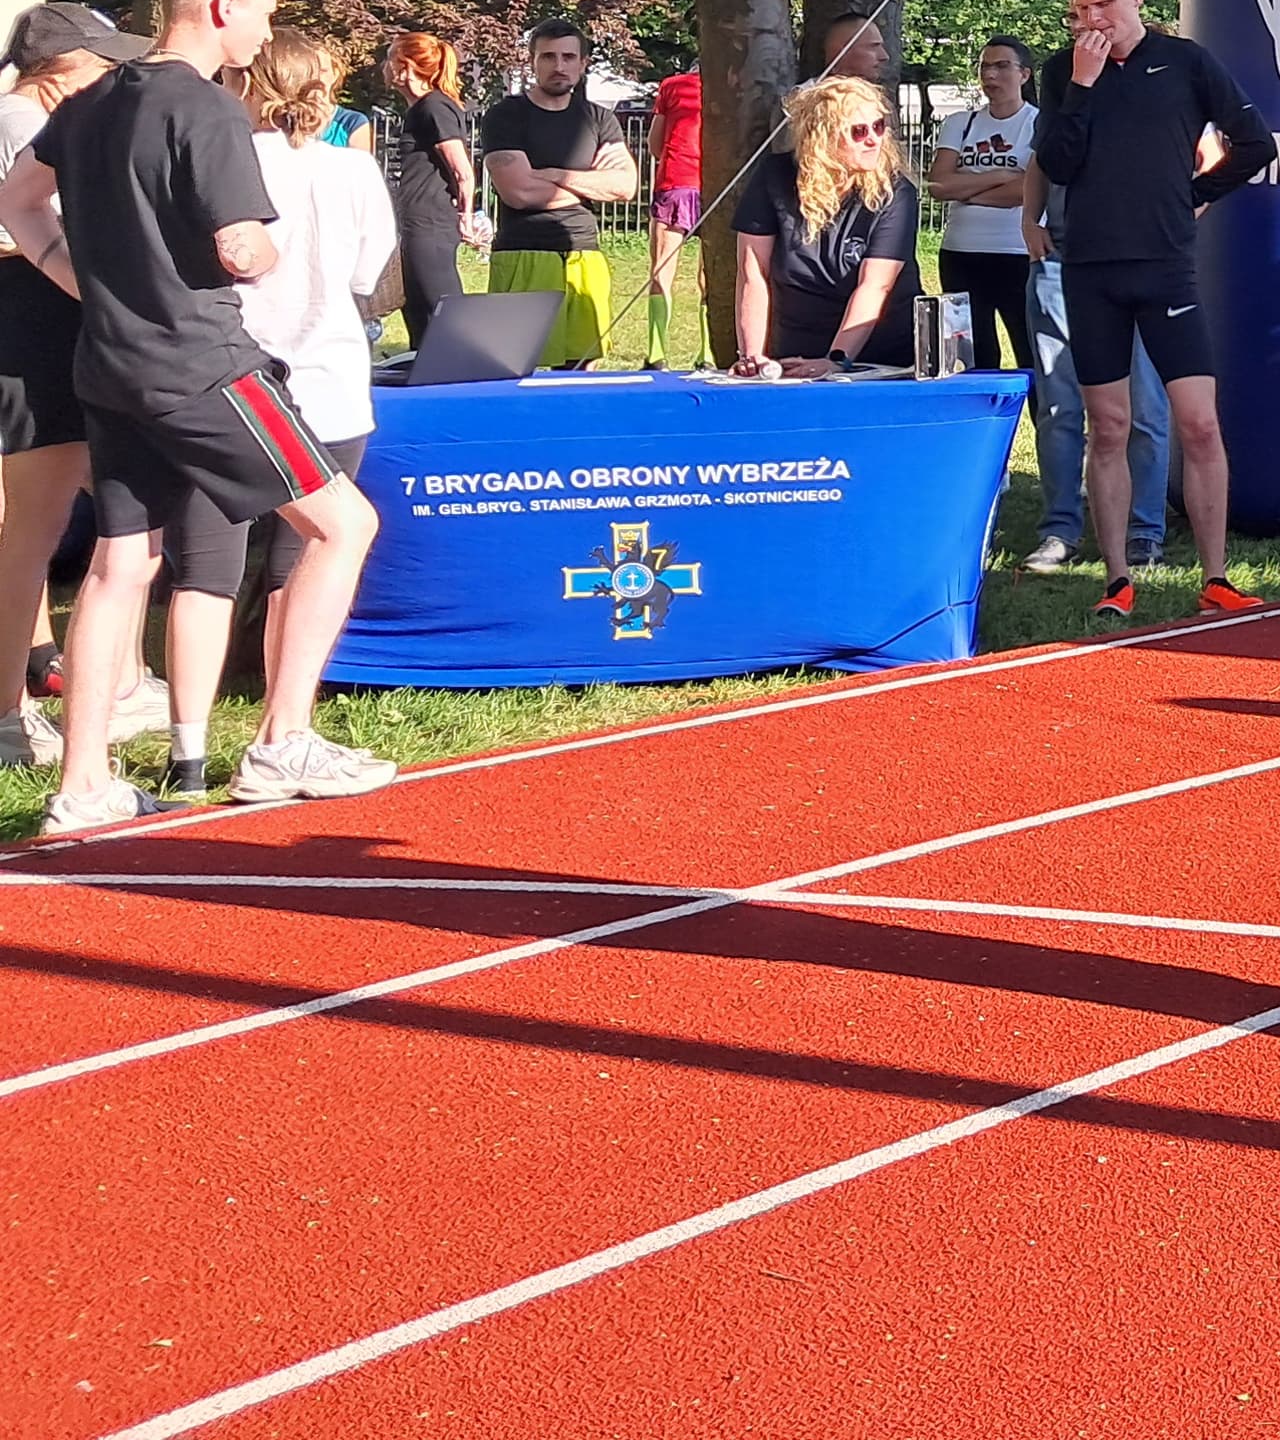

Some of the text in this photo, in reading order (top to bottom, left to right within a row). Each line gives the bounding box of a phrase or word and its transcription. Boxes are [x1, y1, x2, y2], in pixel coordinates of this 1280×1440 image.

[401, 456, 851, 496] 7 BRYGADA OBRONY WYBRZEŻA
[412, 504, 435, 516] IM.
[529, 496, 631, 511] STANISŁAWA
[634, 493, 712, 508] GRZMOTA
[724, 488, 842, 504] SKOTNICKIEGO
[651, 549, 667, 570] 7
